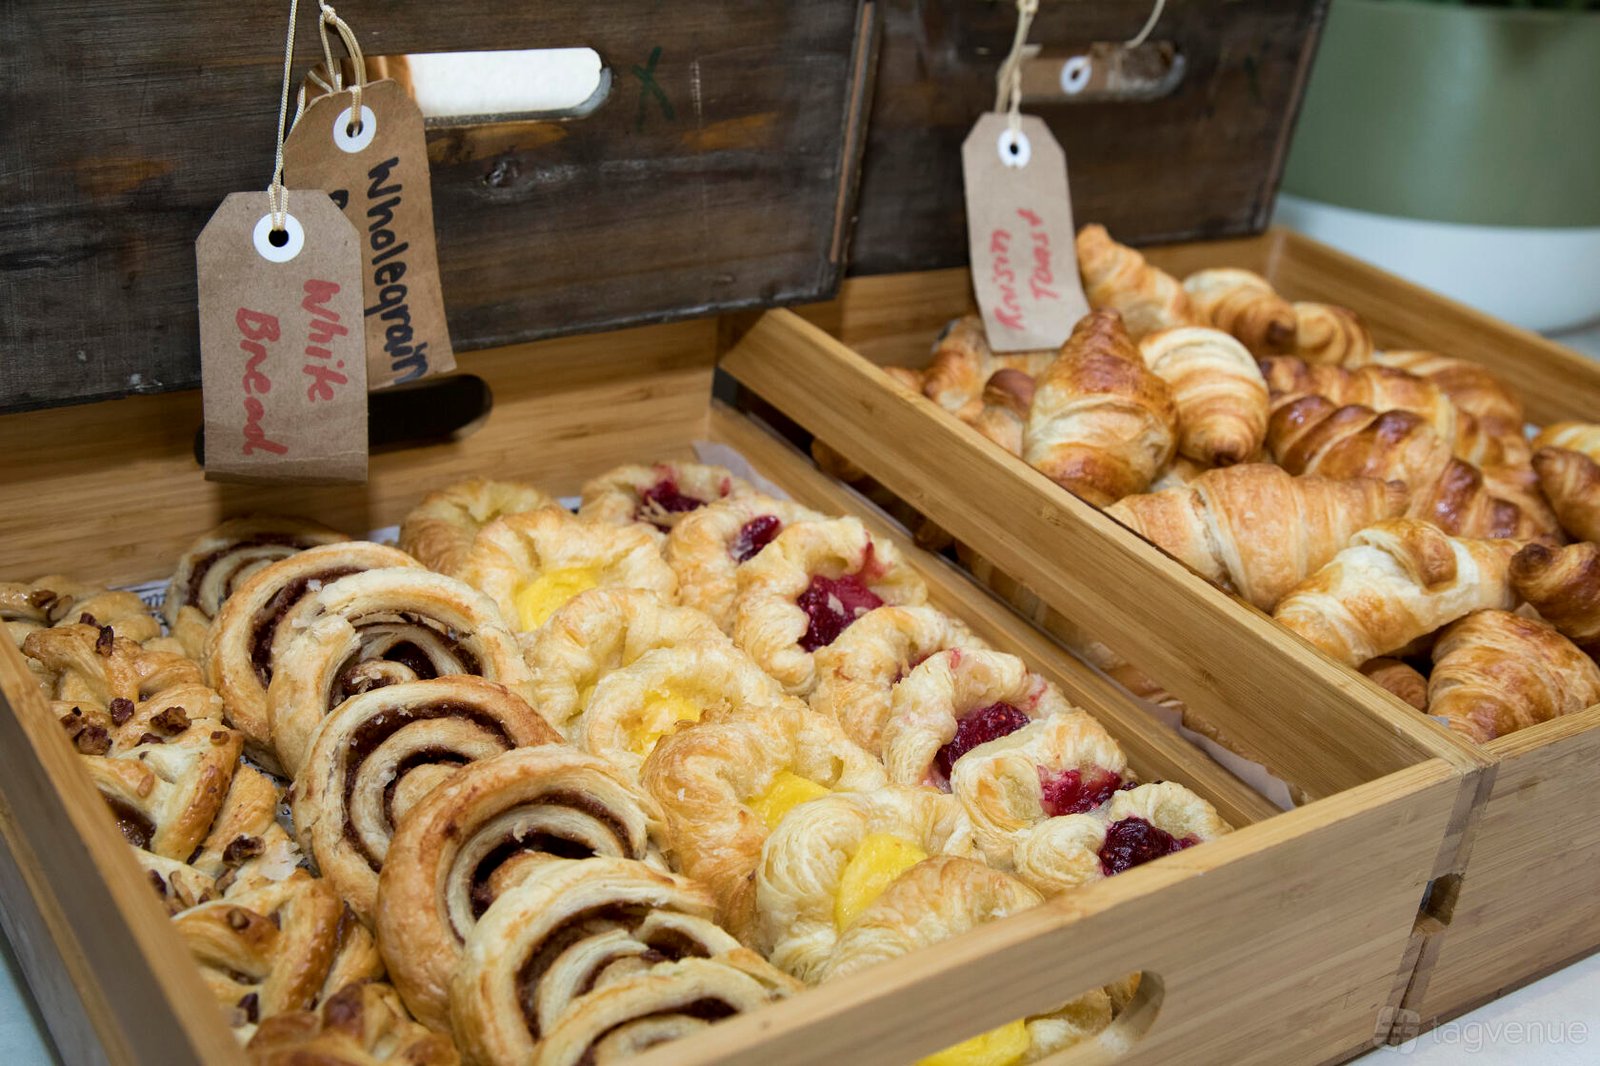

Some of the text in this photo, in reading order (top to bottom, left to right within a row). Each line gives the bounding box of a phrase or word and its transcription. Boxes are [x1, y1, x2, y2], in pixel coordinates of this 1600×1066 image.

[364, 157, 428, 384] Wholegrain
[1016, 208, 1060, 300] Toast
[235, 307, 288, 456] Bread
[302, 279, 348, 402] White
